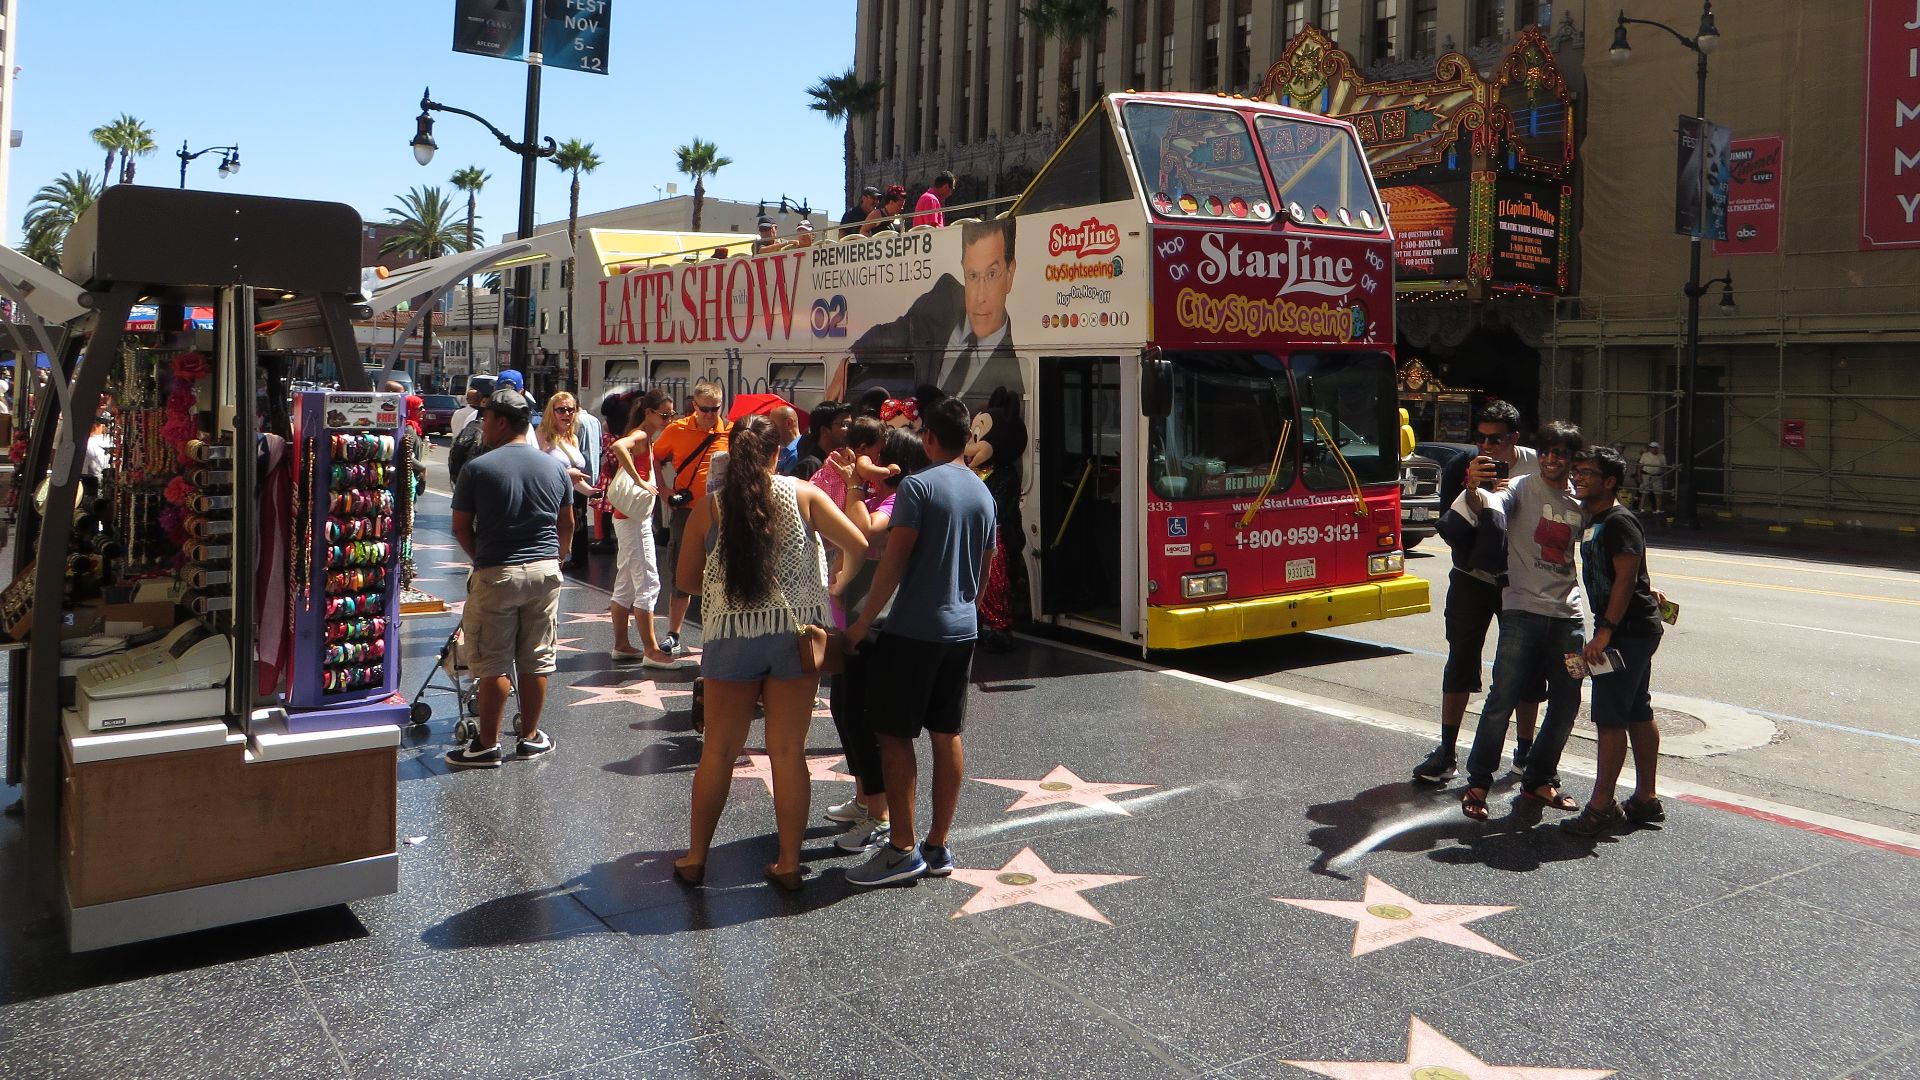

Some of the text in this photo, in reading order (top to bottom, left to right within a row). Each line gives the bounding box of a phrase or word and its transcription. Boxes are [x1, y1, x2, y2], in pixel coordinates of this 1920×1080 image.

[566, 0, 606, 15] FEST
[565, 16, 599, 33] NOV
[580, 56, 602, 72] 12
[1729, 150, 1753, 161] JIMMY
[1753, 173, 1773, 181] LIVE!
[1506, 199, 1531, 218] Capitan
[1532, 201, 1556, 226] Theatre
[1051, 221, 1117, 254] StarLine
[1407, 230, 1433, 240] QUESTIONS
[1432, 229, 1444, 237] CALL
[1736, 227, 1757, 238] abc
[812, 232, 932, 268] PREMIERES SEPT 8
[1158, 236, 1185, 259] Hop
[1412, 248, 1432, 257] THEATRE
[1433, 248, 1442, 256] BOX
[1442, 247, 1458, 255] OFFICE
[1197, 232, 1356, 297] StarLine
[1365, 248, 1384, 271] Hop
[1405, 258, 1414, 266] FOR
[812, 259, 932, 290] WEEKNIGHTS 11:35
[1045, 261, 1113, 282] CitySightseeing
[1169, 263, 1190, 282] On
[1360, 273, 1378, 294] Off
[598, 251, 807, 346] LATE SHOW
[733, 291, 748, 306] with
[1177, 287, 1352, 343] CitySightseeing
[1225, 476, 1244, 491] RED
[1147, 501, 1173, 512] 333
[1235, 522, 1359, 549] 1-800-959-3131
[1287, 564, 1315, 580] 93317E1
